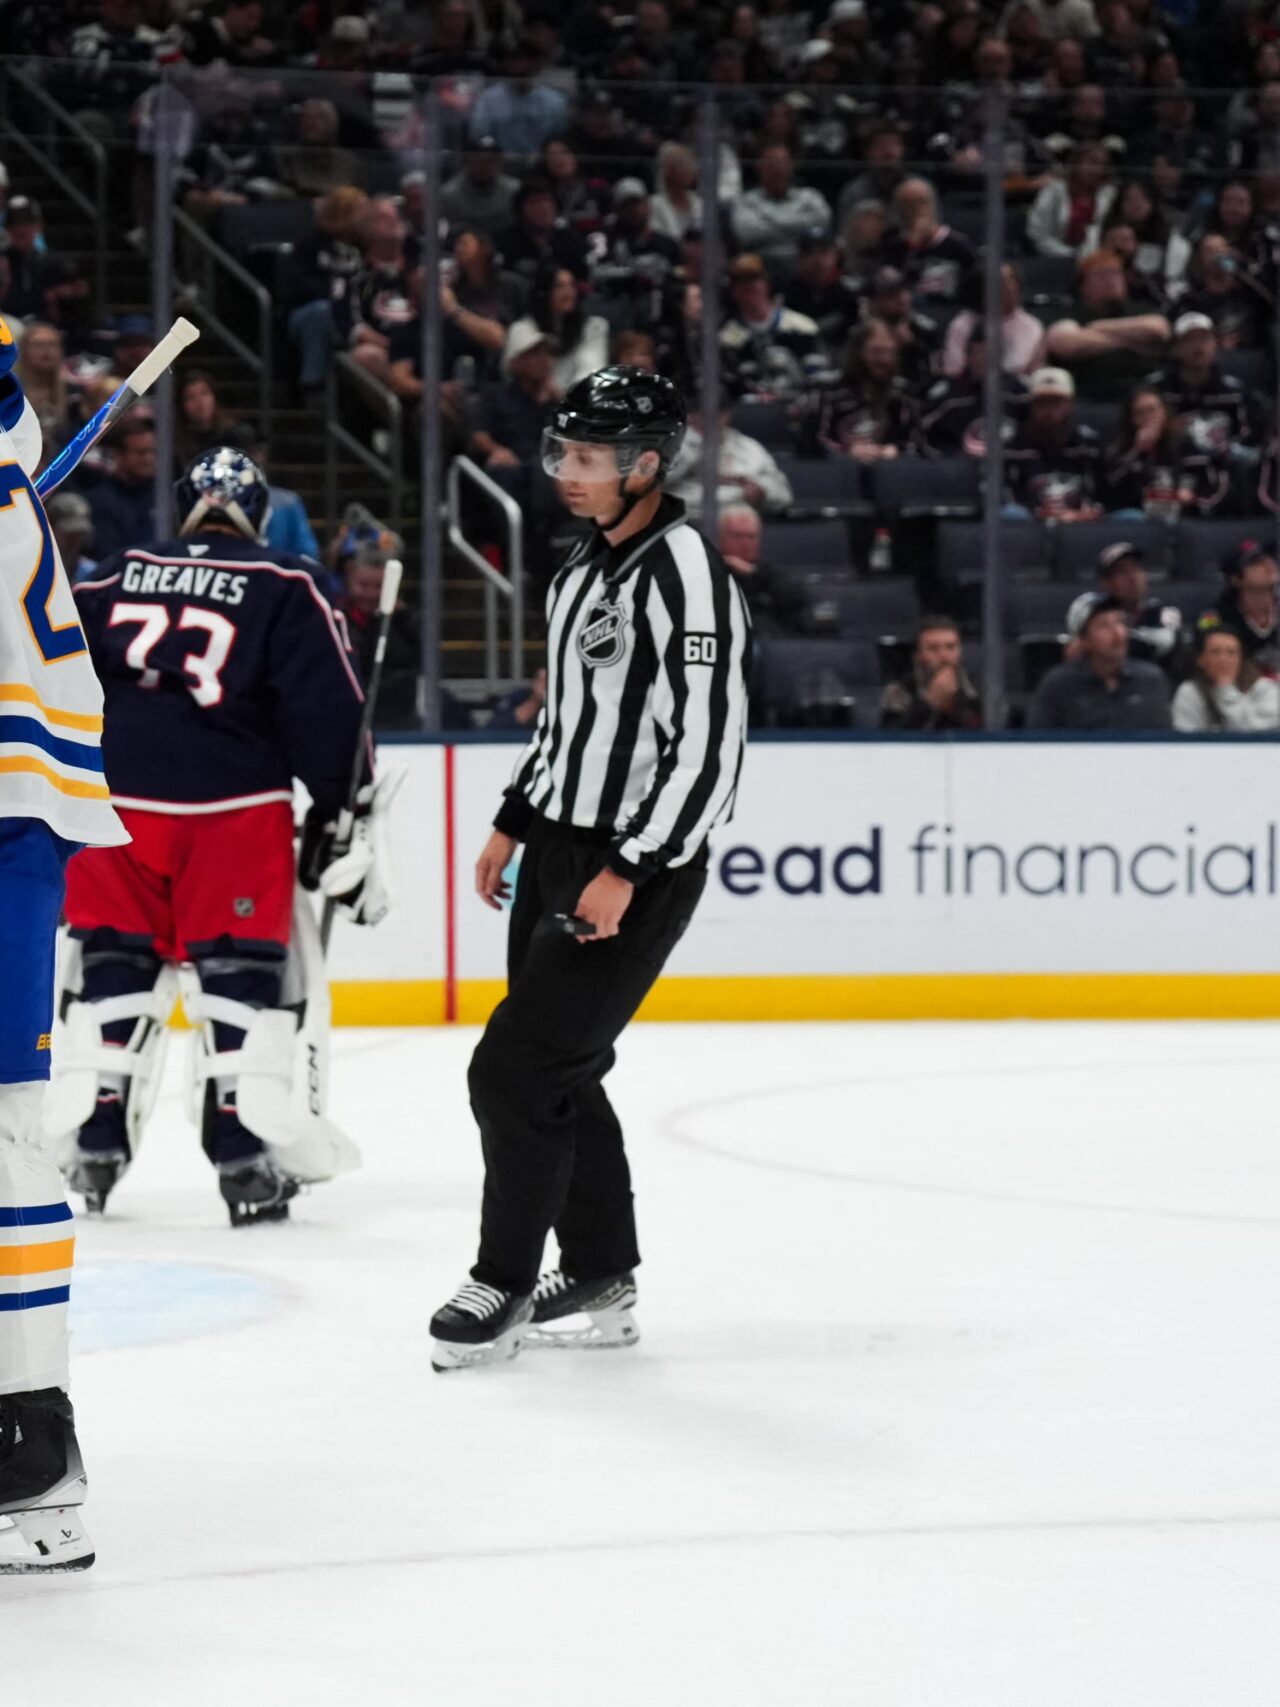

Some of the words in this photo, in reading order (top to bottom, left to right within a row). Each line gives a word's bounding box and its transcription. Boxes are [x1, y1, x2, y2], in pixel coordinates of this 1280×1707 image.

[121, 560, 249, 606] GREAVES
[107, 601, 239, 709] 73
[683, 635, 718, 665] 60
[708, 824, 882, 897] ead
[908, 821, 1276, 897] financial
